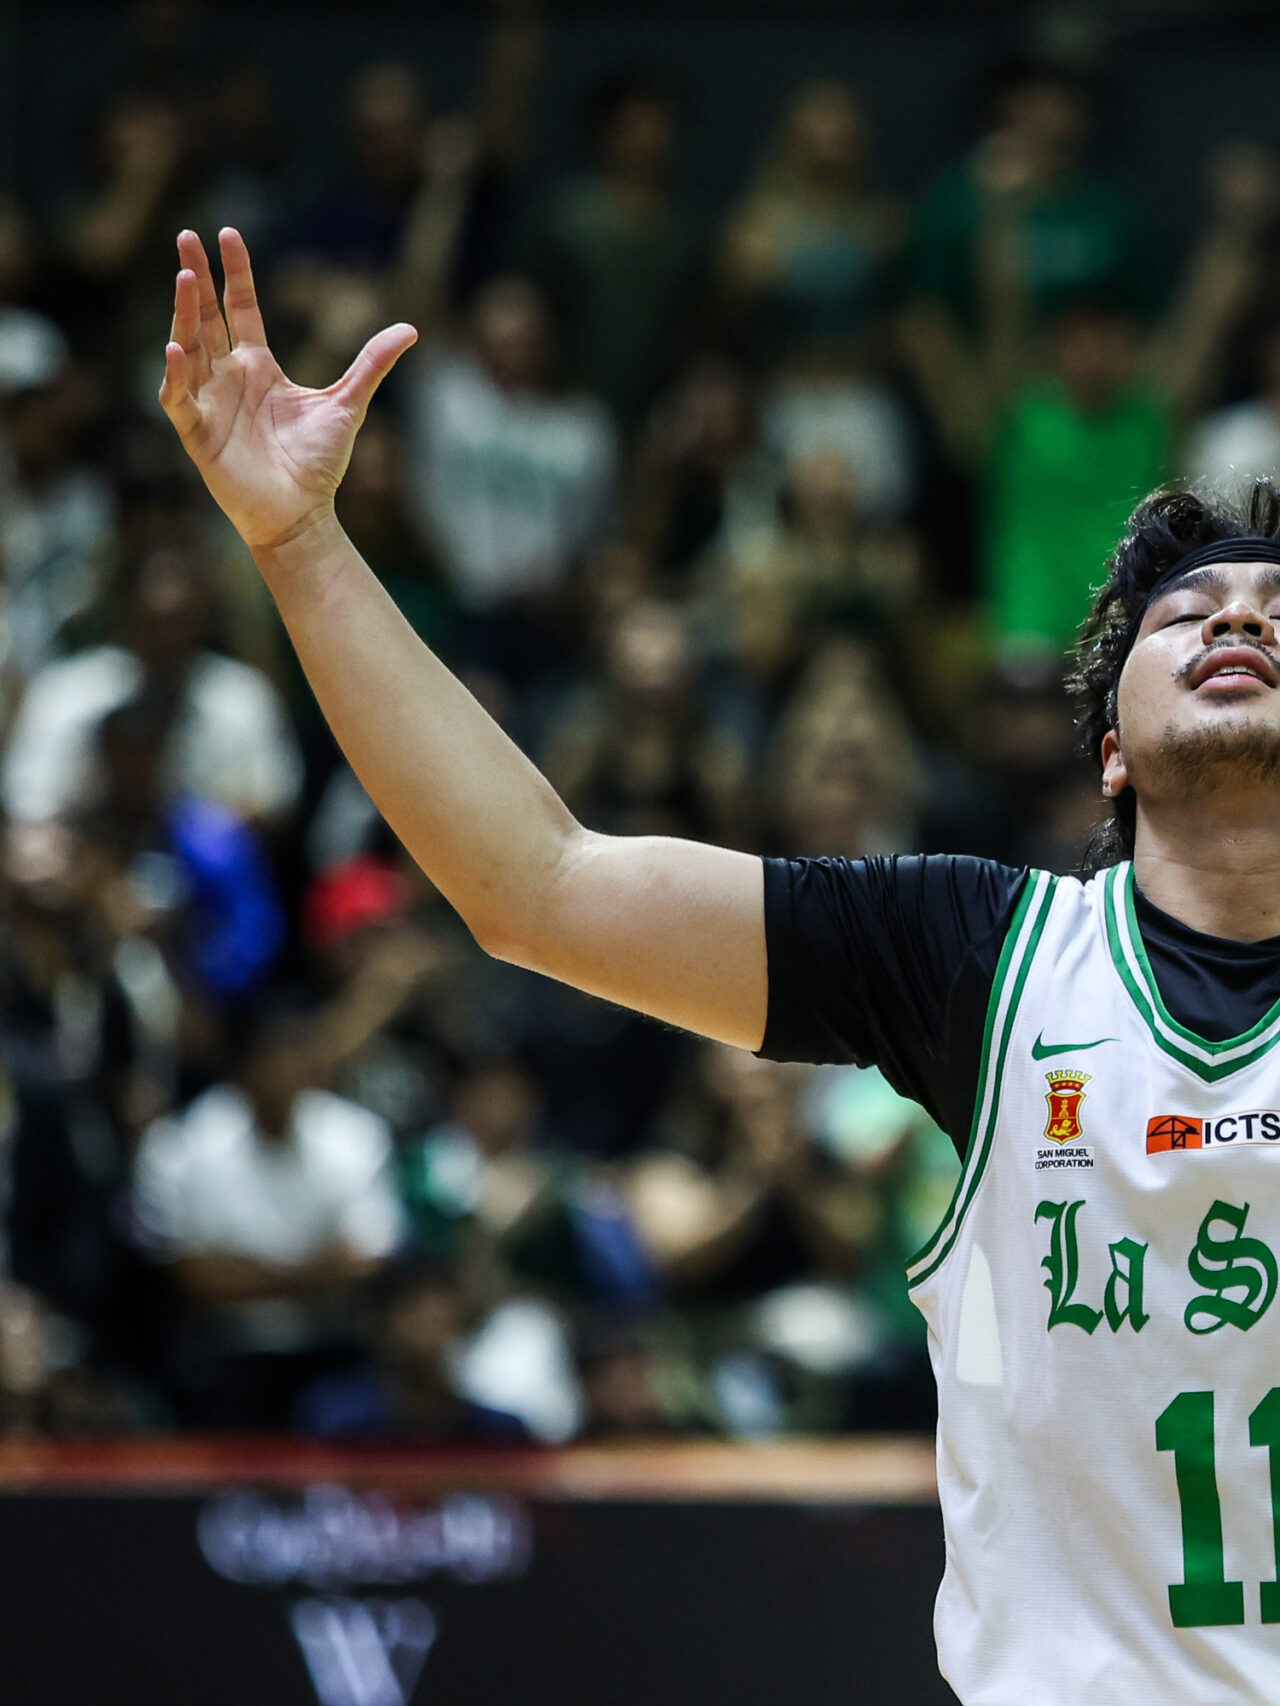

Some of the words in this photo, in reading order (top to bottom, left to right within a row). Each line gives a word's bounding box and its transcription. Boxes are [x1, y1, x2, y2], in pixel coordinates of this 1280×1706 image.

[1037, 1150, 1053, 1159] SAN
[1055, 1148, 1089, 1158] MIGUEL
[1035, 1159, 1093, 1169] CORPORATION
[1034, 1200, 1150, 1335] La
